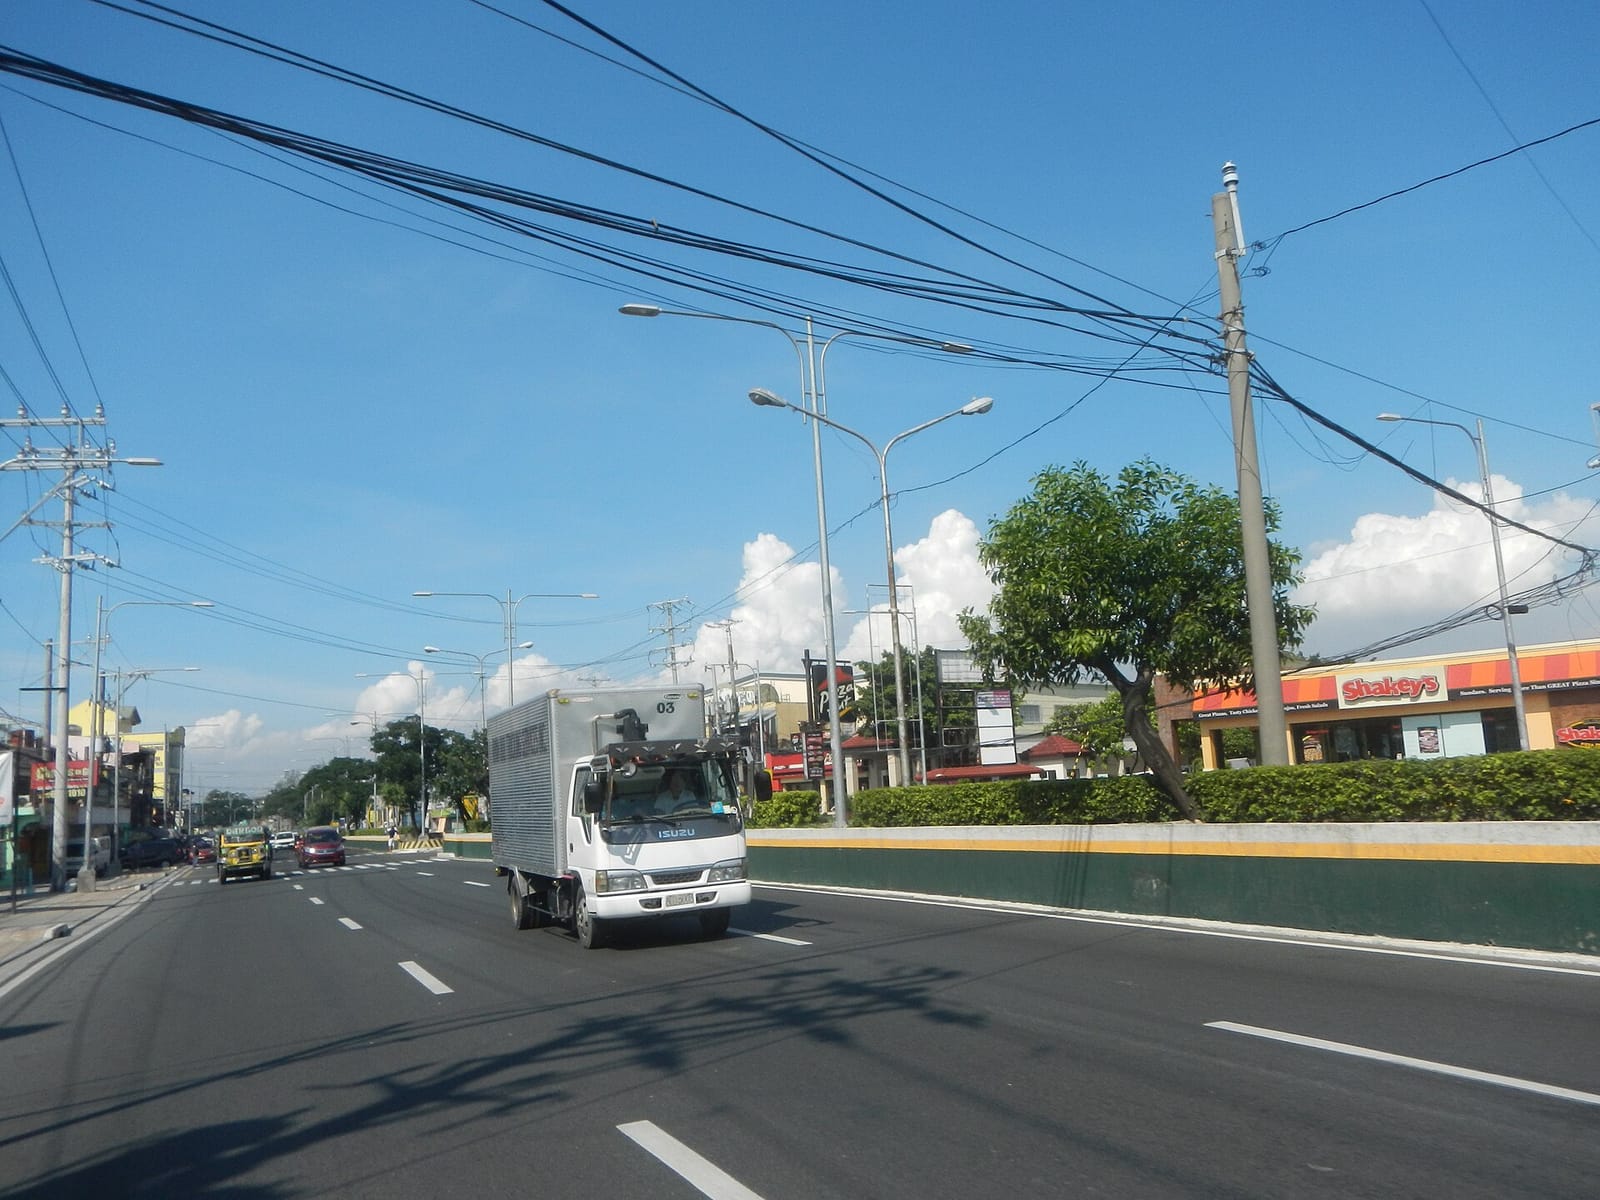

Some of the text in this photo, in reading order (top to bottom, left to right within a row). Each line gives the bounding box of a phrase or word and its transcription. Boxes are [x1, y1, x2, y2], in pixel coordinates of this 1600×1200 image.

[1342, 675, 1439, 701] Shakey's
[657, 702, 675, 714] 03
[658, 828, 696, 839] ISUZU
